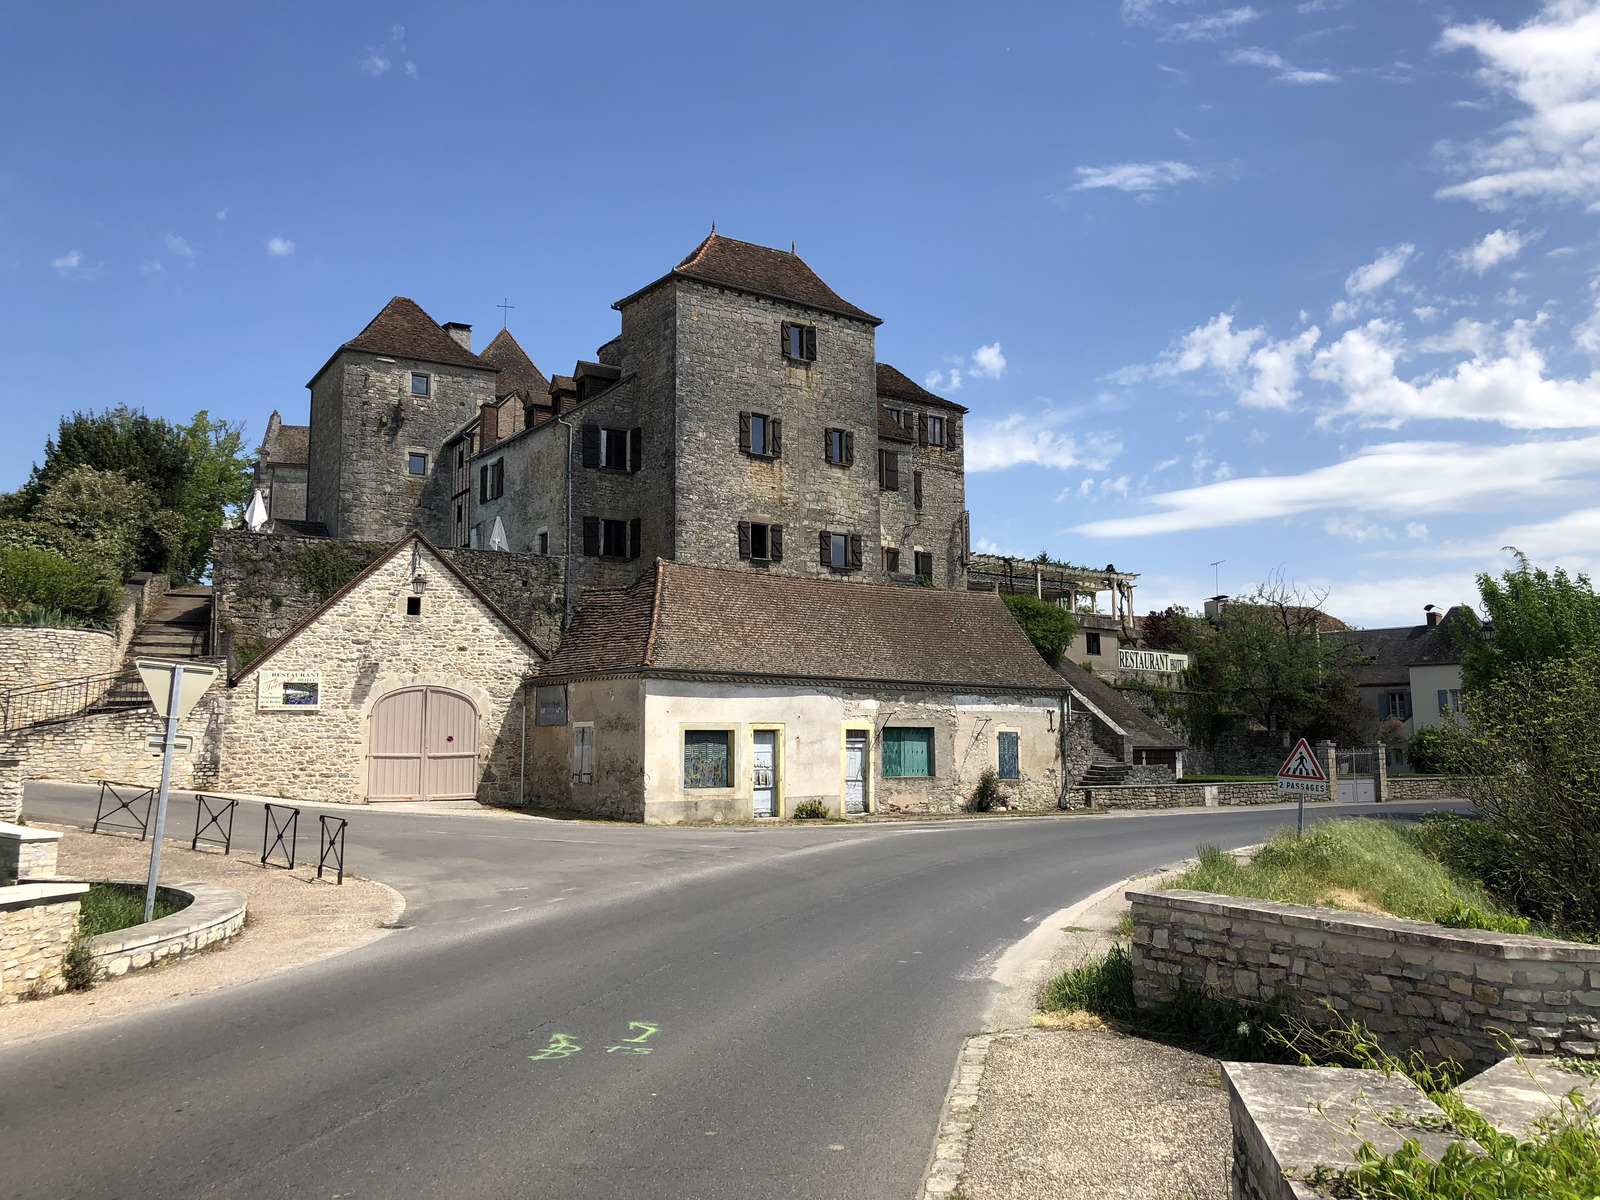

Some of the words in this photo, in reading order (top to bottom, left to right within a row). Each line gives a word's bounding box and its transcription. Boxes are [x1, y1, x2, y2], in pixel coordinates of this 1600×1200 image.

[1119, 650, 1169, 671] RESTAURANT
[1279, 781, 1284, 789] 2
[1286, 782, 1325, 792] PASSAGES
